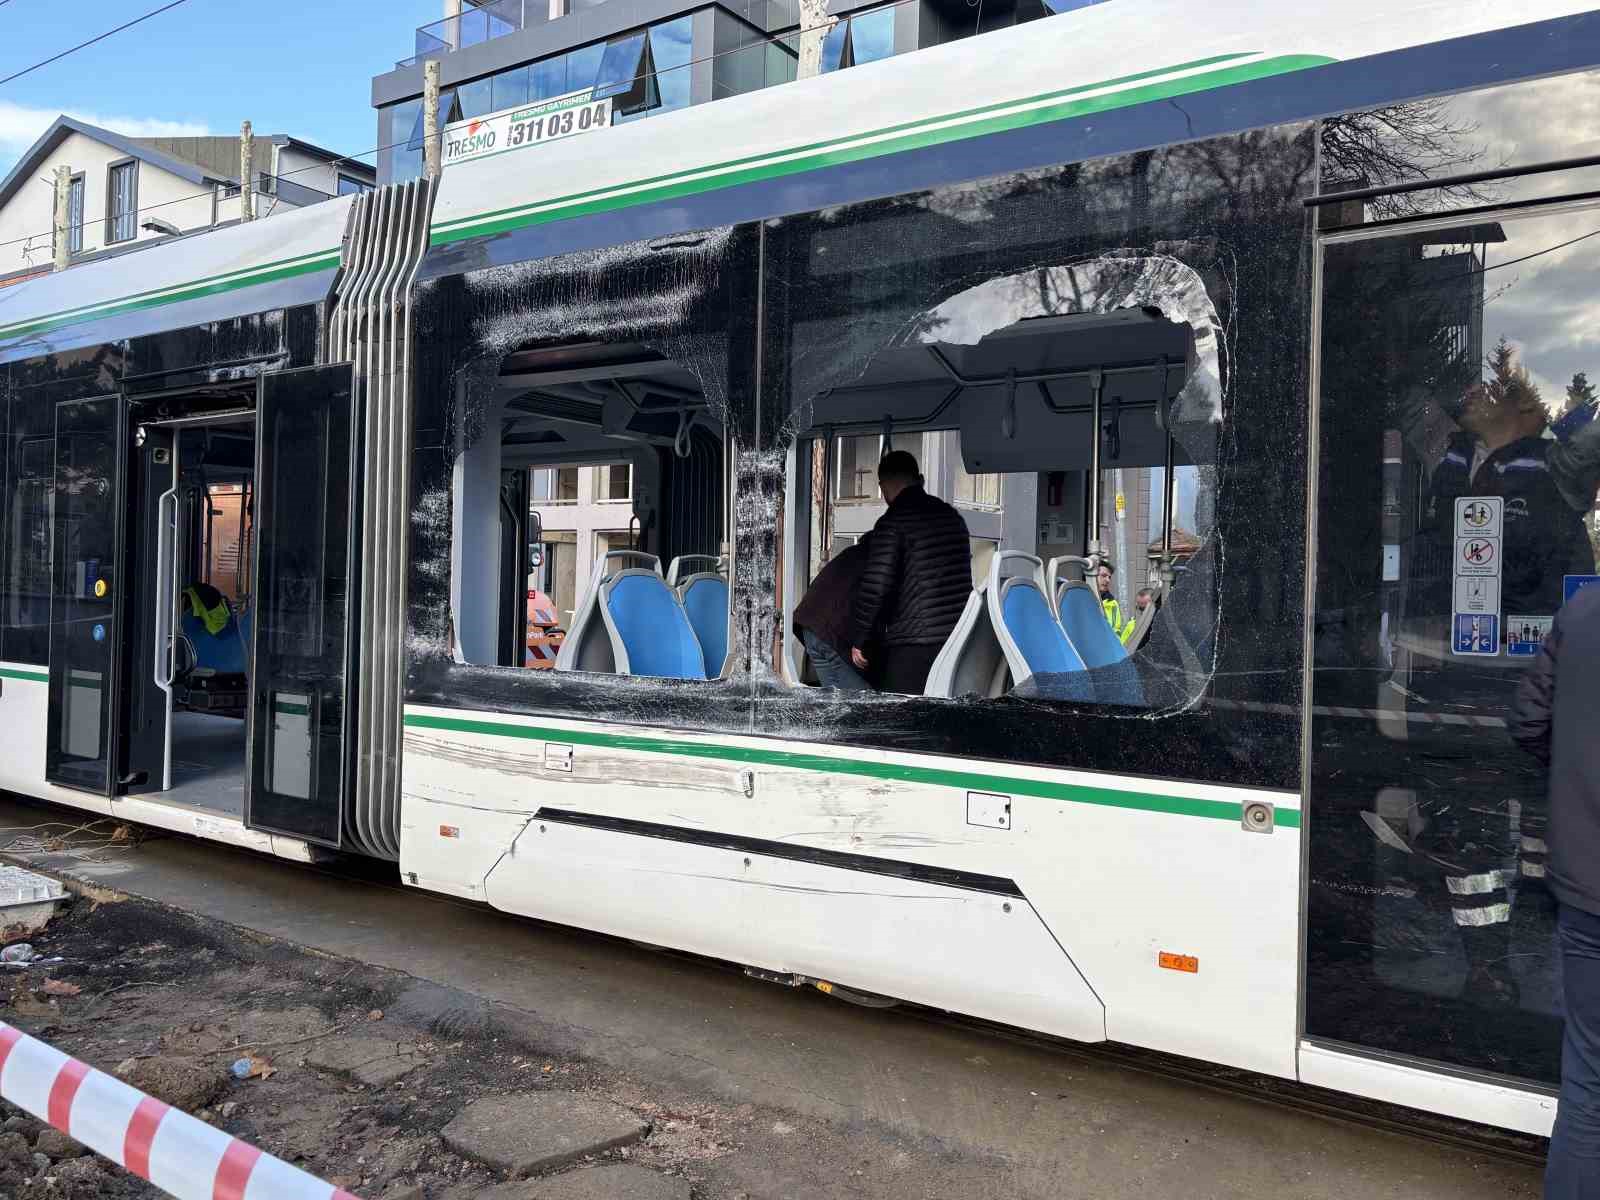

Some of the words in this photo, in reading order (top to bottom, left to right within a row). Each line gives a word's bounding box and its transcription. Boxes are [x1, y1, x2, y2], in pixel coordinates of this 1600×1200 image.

[513, 117, 544, 145] 311
[547, 110, 574, 137] 03
[578, 103, 606, 130] 04
[448, 131, 496, 157] TRESMO
